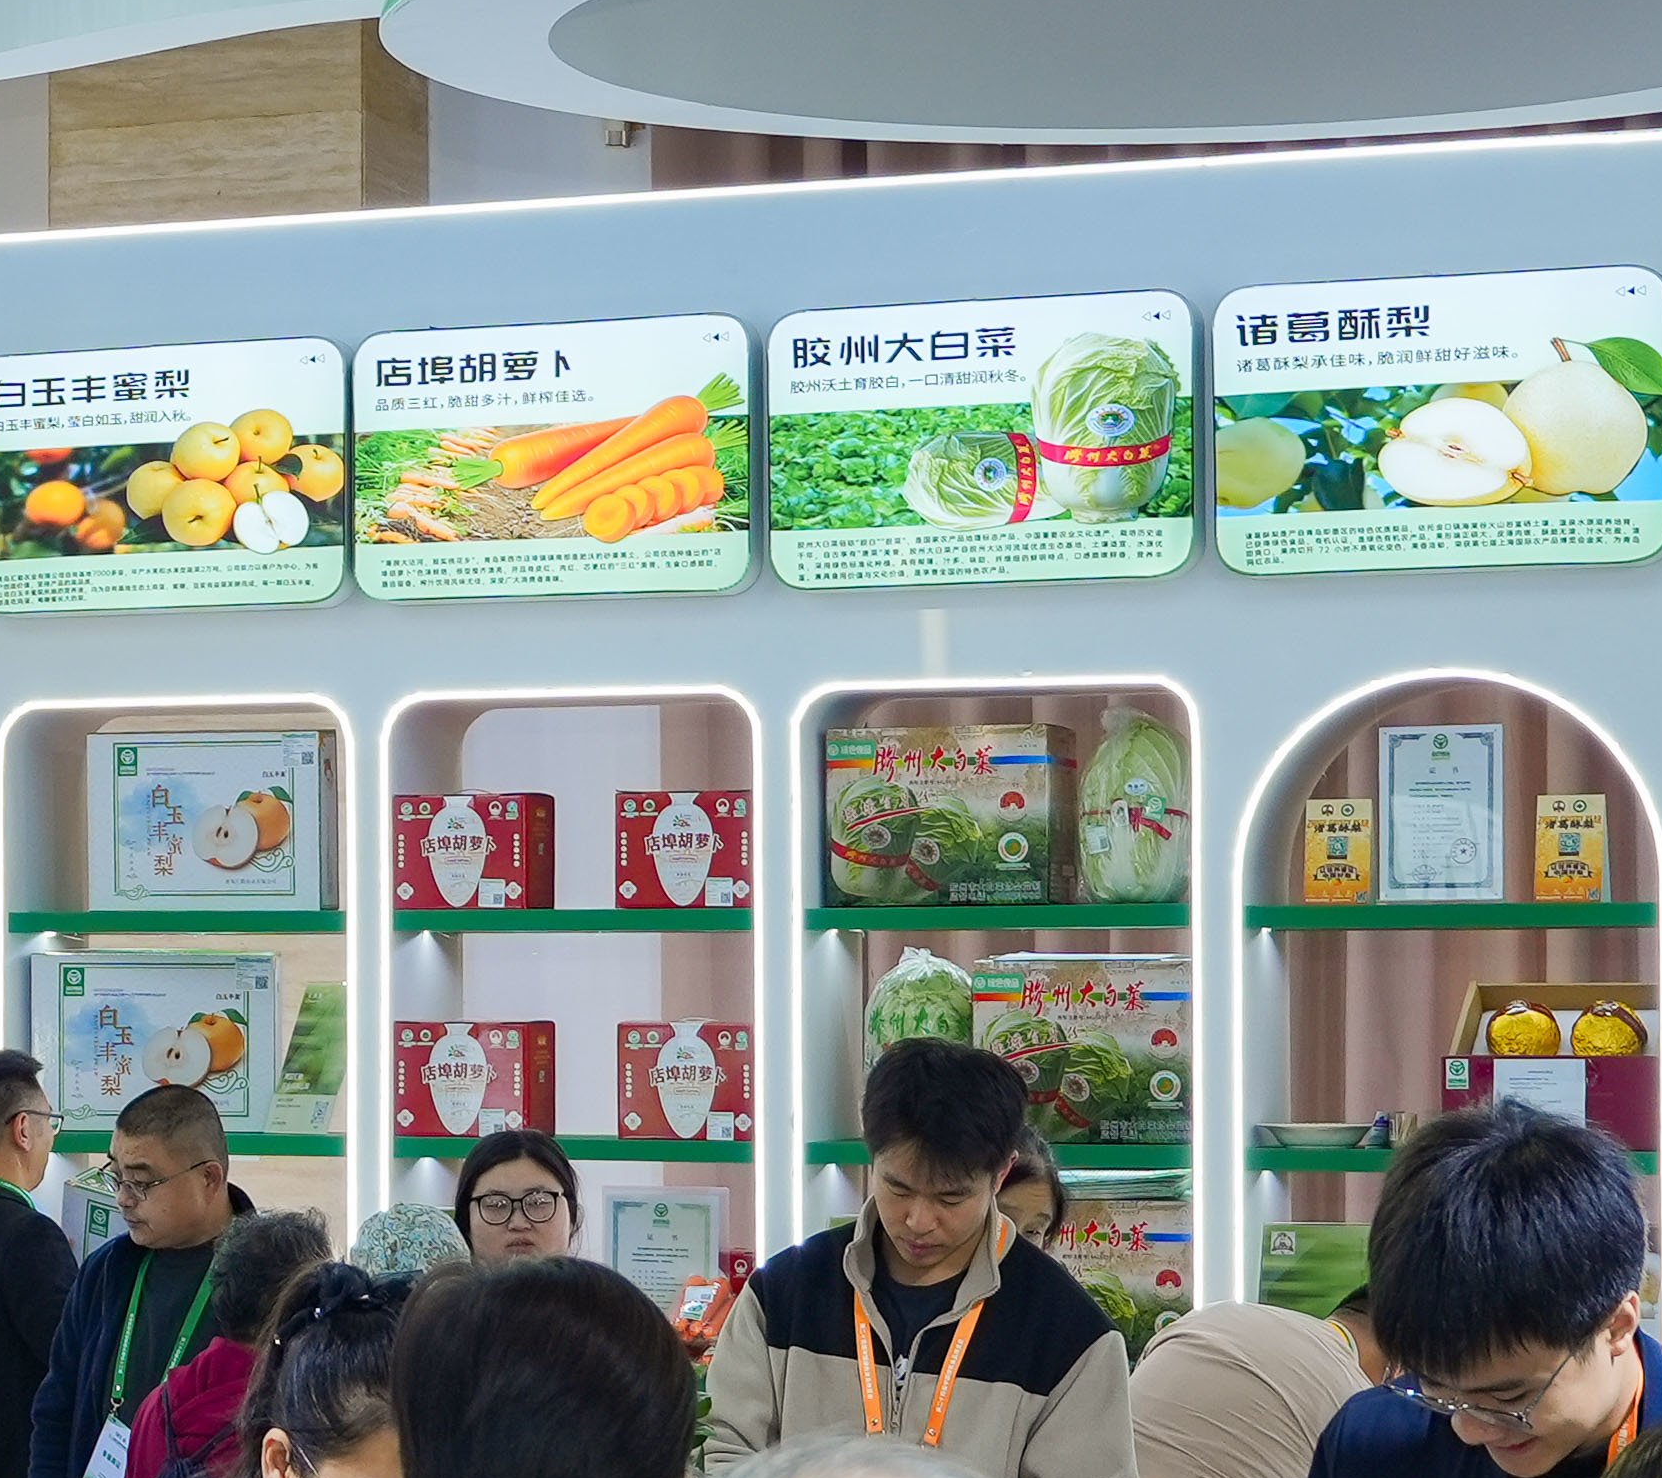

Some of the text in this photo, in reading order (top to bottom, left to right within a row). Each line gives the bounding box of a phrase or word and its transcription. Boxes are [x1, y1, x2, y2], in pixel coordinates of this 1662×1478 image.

[1236, 304, 1431, 347] 诸葛酥梨
[792, 327, 1017, 369] 胶州大白菜
[376, 350, 570, 388] 店埠胡萝卜
[421, 834, 496, 856] 店埠胡萝卜
[645, 833, 724, 855] 店埠胡萝卜
[421, 1063, 496, 1085] 店埠胡萝卜
[649, 1064, 725, 1086] 店埠胡萝卜
